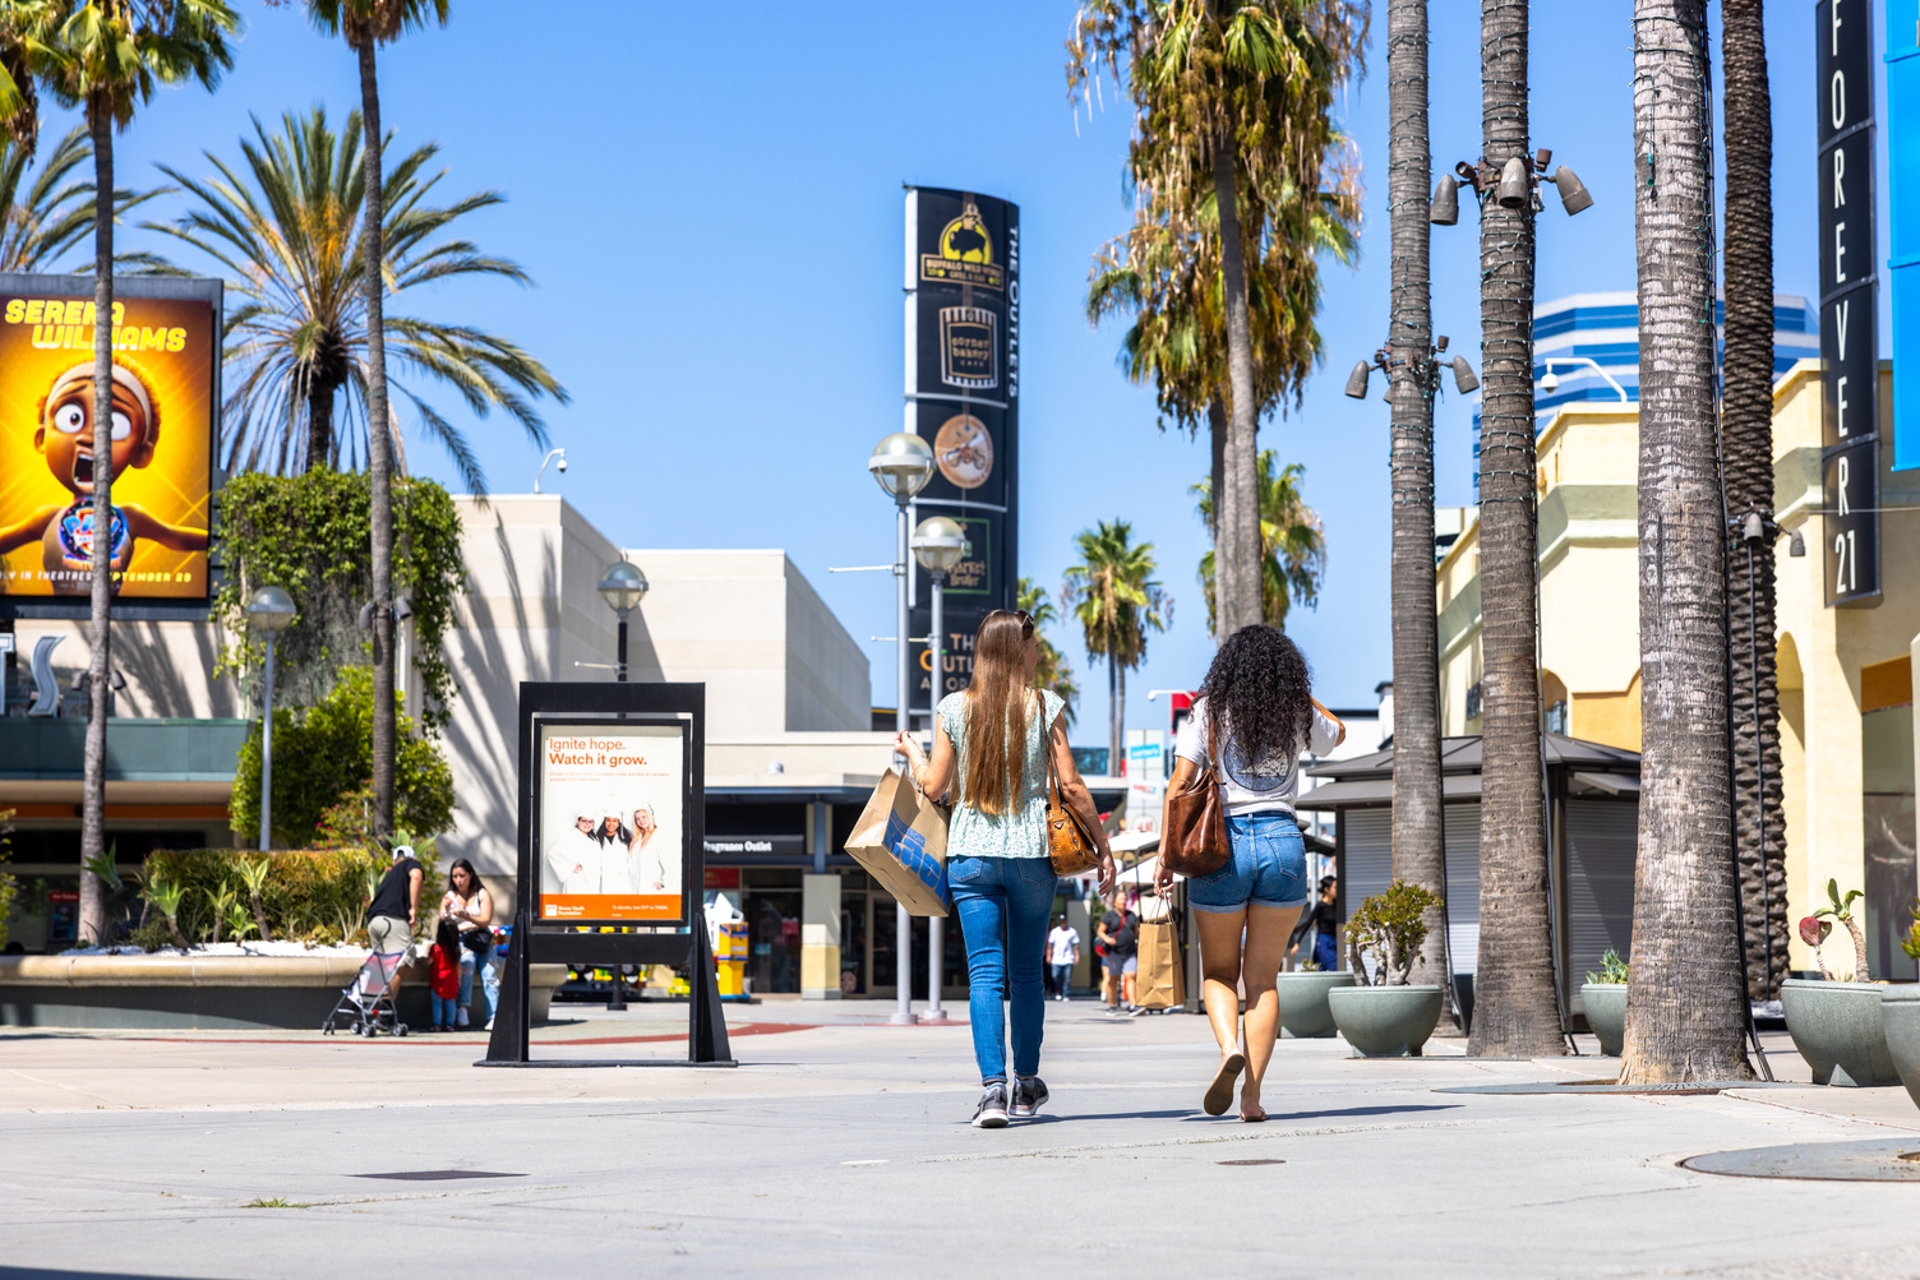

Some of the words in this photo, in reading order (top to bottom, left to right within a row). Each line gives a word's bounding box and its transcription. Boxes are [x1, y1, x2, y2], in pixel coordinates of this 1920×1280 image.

[1009, 226, 1018, 271] THE
[1009, 281, 1018, 397] OUTLETS
[952, 346, 988, 360] bakery
[1835, 529, 1855, 594] 21
[20, 571, 32, 580] IN
[37, 571, 92, 581] THEATRES
[950, 633, 975, 651] TH
[549, 737, 586, 752] Ignite
[589, 737, 626, 752] hope.
[549, 753, 594, 765] Watch
[597, 753, 606, 765] it
[609, 756, 647, 768] grow.
[744, 840, 772, 852] Outlet
